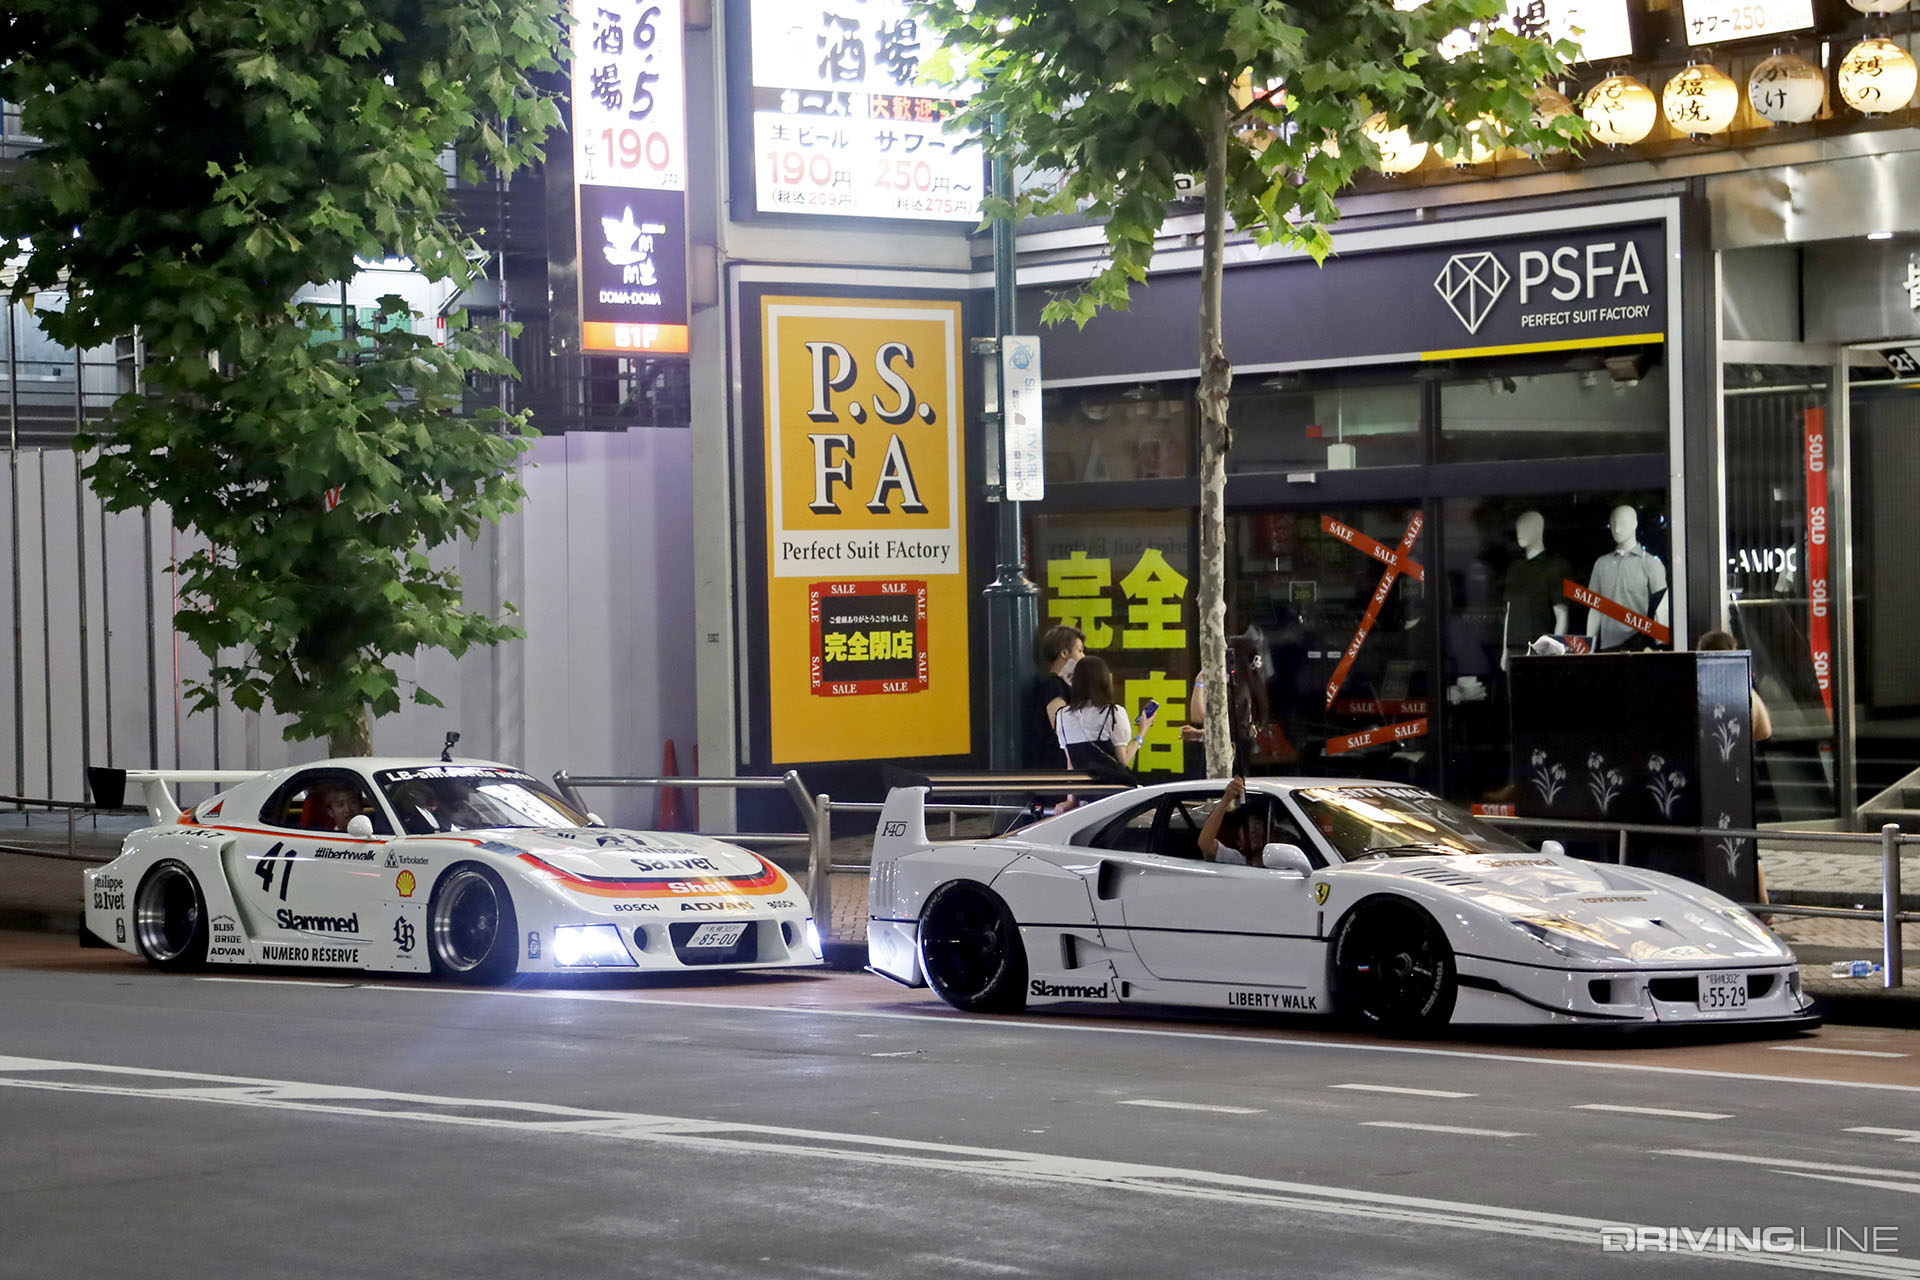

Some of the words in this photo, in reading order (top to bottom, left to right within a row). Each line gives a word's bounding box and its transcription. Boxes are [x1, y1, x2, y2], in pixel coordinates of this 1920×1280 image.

[590, 7, 623, 111] 酒場
[816, 11, 921, 87] 酒場
[770, 124, 849, 149] 生ビール
[602, 128, 669, 171] 190
[1520, 241, 1649, 304] PSFA
[1522, 310, 1569, 327] PERFECT
[1573, 308, 1597, 323] SUIT
[1600, 305, 1650, 322] FACTORY
[614, 325, 659, 348] B1F
[805, 342, 935, 425] P.S.
[1809, 434, 1823, 472] SOLD
[807, 433, 928, 514] FA
[1404, 517, 1423, 547] SALE
[1811, 506, 1825, 545] SOLD
[783, 541, 841, 560] Perfect
[847, 541, 879, 559] Suit
[1329, 523, 1354, 541] SALE
[1374, 546, 1397, 565] SALE
[831, 585, 856, 594] SALE
[881, 583, 907, 593] SALE
[1047, 548, 1189, 648] 完全
[1377, 572, 1393, 602] SALE
[1812, 579, 1827, 617] SOLD
[810, 591, 819, 623] SALE
[917, 588, 926, 620] SALE
[1574, 588, 1601, 608] SALE
[1624, 612, 1652, 633] SALE
[824, 630, 914, 662] 完全閉店
[1349, 628, 1366, 658] SALE
[811, 656, 821, 688] SALE
[919, 652, 927, 683] SALE
[832, 684, 857, 694] SALE
[882, 682, 908, 692] SALE
[1350, 703, 1374, 713] SALE
[1401, 703, 1426, 713] SALE
[1348, 734, 1371, 748] SALE
[1395, 722, 1420, 737] SALE
[882, 821, 908, 837] F40
[255, 841, 297, 901] 41
[399, 855, 430, 864] Turbolader
[94, 875, 123, 892] philippe
[667, 881, 734, 893] Shell
[613, 904, 660, 912] BOSCH
[681, 902, 755, 912] ADVAN
[214, 923, 235, 931] BLISS
[276, 908, 359, 933] Slammed
[215, 935, 241, 943] BRIDE
[699, 933, 738, 945] 85-00
[210, 948, 245, 956] ADVAN
[263, 946, 309, 961] NUMERO
[312, 946, 359, 963] RÉSERVÉ
[1030, 979, 1108, 999] Slammed
[1228, 992, 1281, 1008] LIBERTY
[1283, 993, 1317, 1010] WALK
